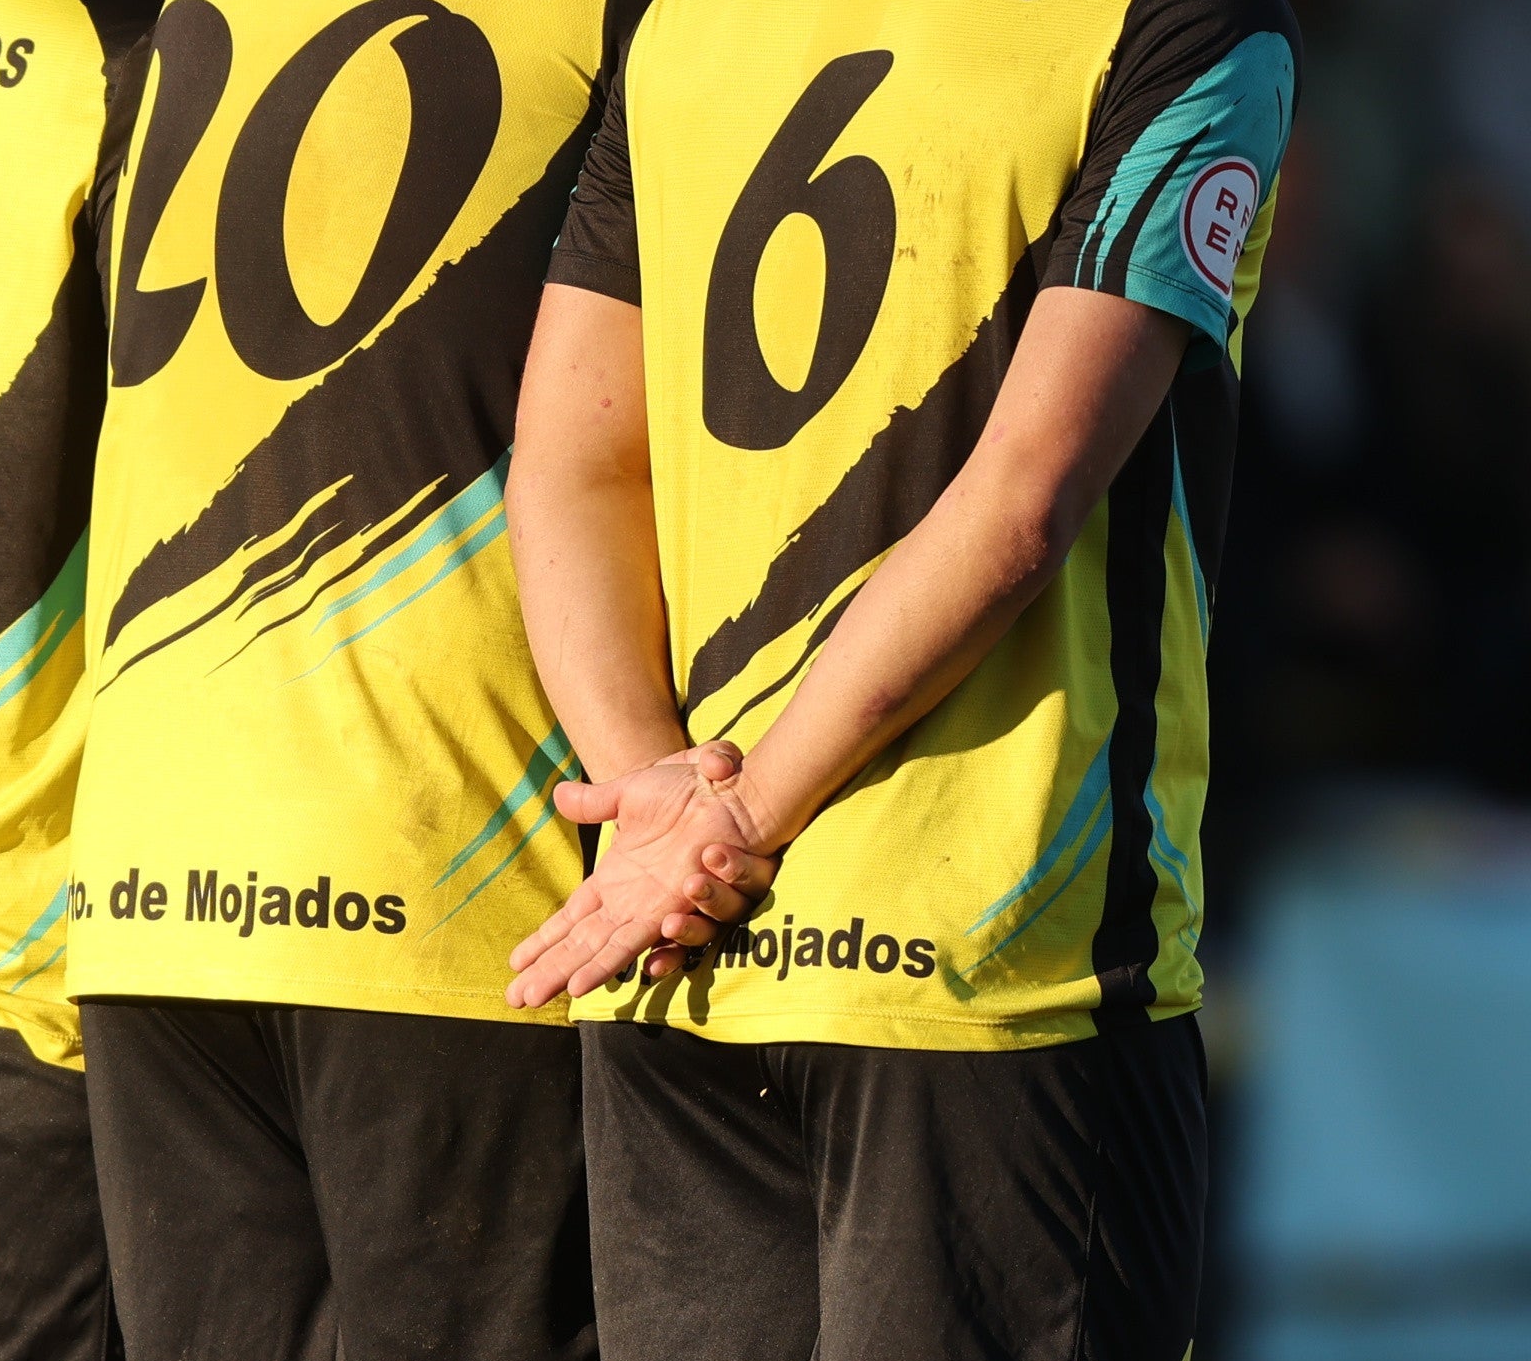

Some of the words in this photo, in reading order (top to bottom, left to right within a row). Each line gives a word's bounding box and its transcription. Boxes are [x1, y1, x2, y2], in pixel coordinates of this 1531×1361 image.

[702, 49, 897, 451] 6
[109, 867, 168, 922] de
[185, 869, 407, 938] Mojados
